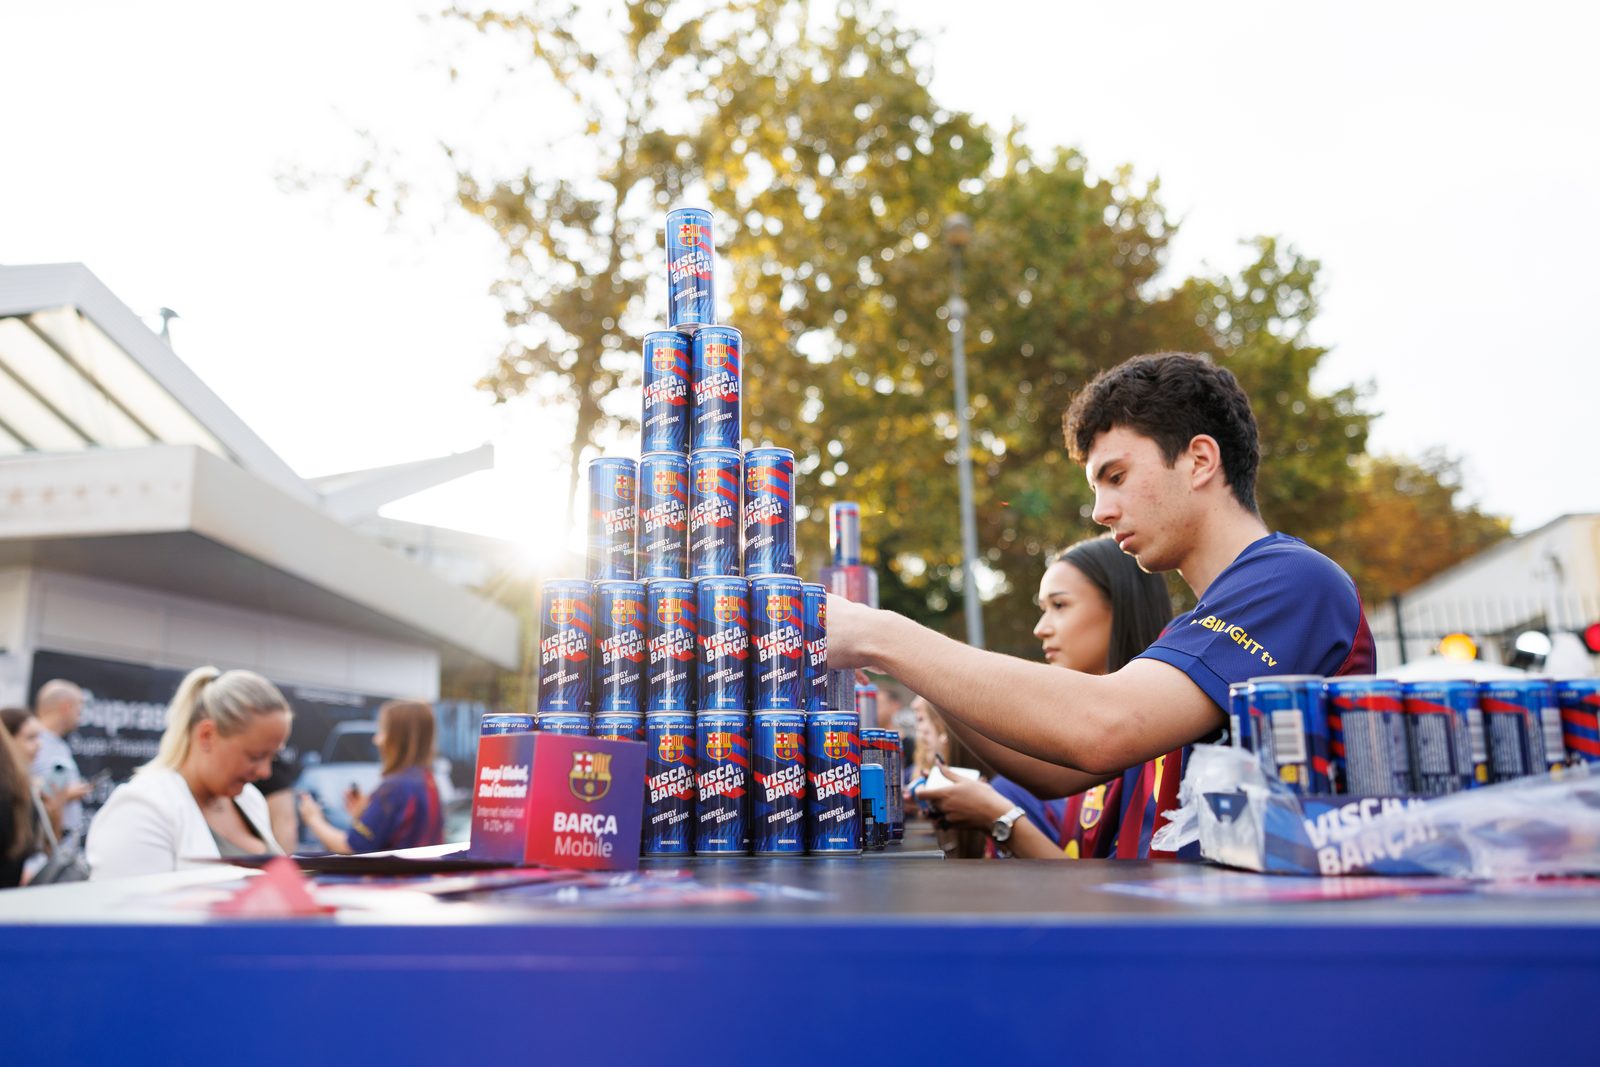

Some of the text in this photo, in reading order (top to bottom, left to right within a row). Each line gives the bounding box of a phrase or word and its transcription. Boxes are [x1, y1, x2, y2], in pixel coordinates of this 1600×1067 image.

[670, 251, 704, 273] VISCA
[672, 260, 713, 284] BARÇA!
[643, 375, 678, 398] VISCA
[694, 371, 731, 394] VISCA
[697, 381, 738, 406] BARÇA!
[645, 384, 687, 410] BARÇA!
[642, 499, 680, 522] VISCA
[690, 496, 722, 521] VISCA
[744, 494, 772, 518] ISCA
[644, 509, 687, 534] BARÇA!
[691, 505, 733, 533] BARÇA!
[754, 536, 775, 549] DRINK
[541, 628, 577, 653] VISCA
[600, 629, 638, 653] VISCA
[648, 628, 685, 653] VISCA
[703, 626, 741, 651] VISCA
[756, 625, 795, 650] VISCA
[759, 635, 802, 662] BARÇA!
[542, 638, 587, 665] BARÇA!
[602, 639, 646, 665] BARÇA!
[650, 637, 694, 665] BARÇA!
[706, 636, 749, 663] BARÇA!
[1261, 651, 1278, 667] tv
[543, 669, 567, 685] ENERGY
[558, 672, 579, 685] DRINK
[603, 670, 629, 685] ENERGY
[620, 673, 640, 685] DRINK
[651, 669, 675, 685] ENERGY
[666, 671, 687, 684] DRINK
[707, 667, 733, 683] ENERGY
[725, 670, 744, 683] DRINK
[761, 667, 786, 683] ENERGY
[778, 670, 798, 683] DRINK
[648, 765, 687, 791] VISCA
[698, 763, 735, 789] VISCA
[762, 764, 801, 789] VISCA
[813, 762, 853, 788] VISCA
[816, 771, 860, 801] BARÇA!
[650, 774, 695, 804] BARÇA!
[699, 772, 745, 802] BARÇA!
[553, 811, 618, 837] BARÇA
[651, 808, 677, 825] ENERGY
[668, 811, 689, 825] DRINK
[700, 807, 725, 823] ENERGY
[716, 809, 738, 823] DRINK
[767, 807, 794, 823] ENERGY
[786, 810, 804, 824] DRINK
[818, 806, 844, 822] ENERGY
[836, 809, 856, 822] DRINK
[554, 835, 613, 857] Mobile
